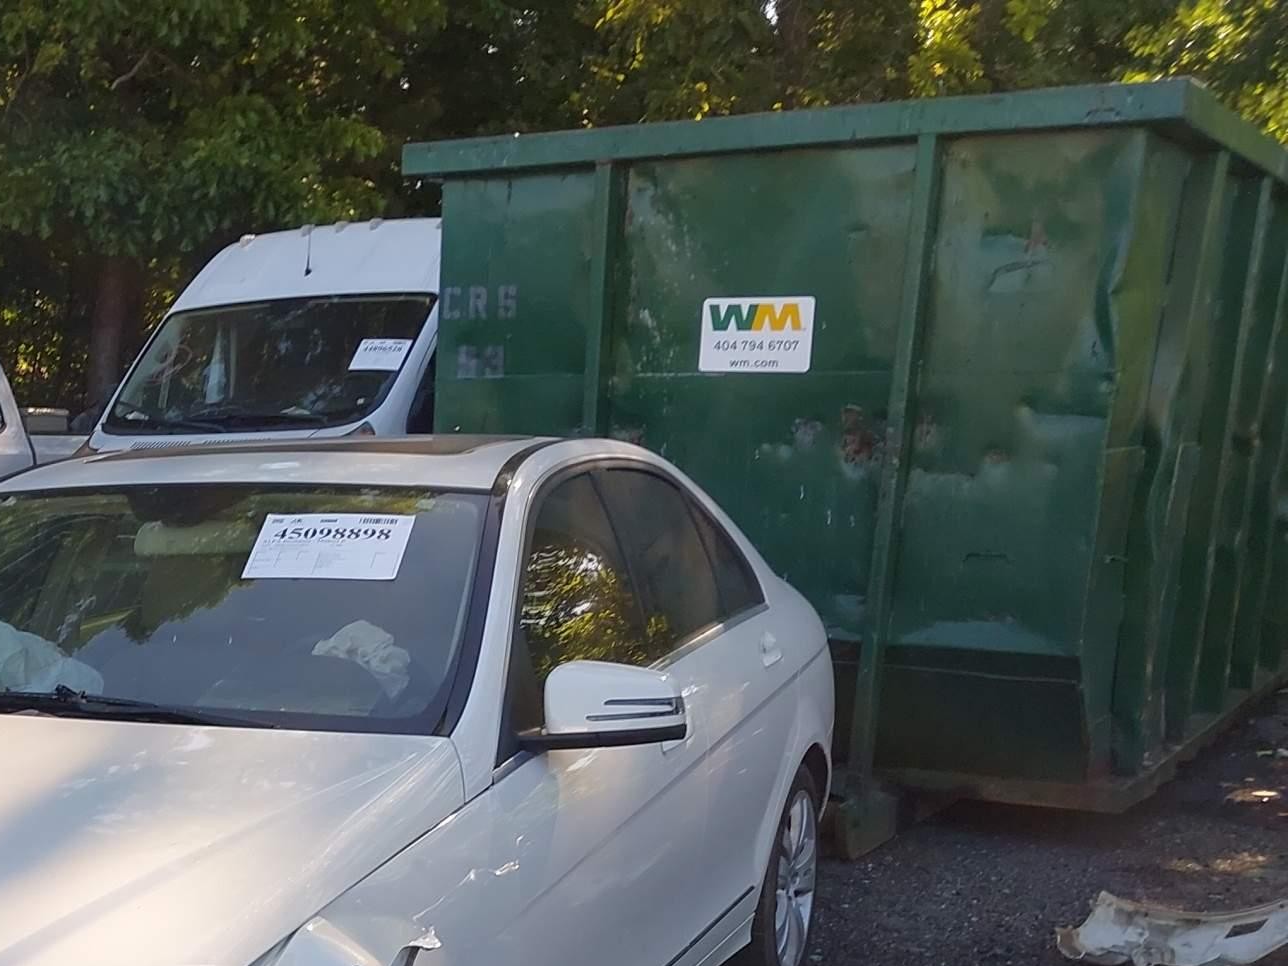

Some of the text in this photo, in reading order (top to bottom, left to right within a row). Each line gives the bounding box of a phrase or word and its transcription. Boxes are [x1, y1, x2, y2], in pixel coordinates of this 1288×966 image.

[709, 303, 802, 331] WM
[714, 340, 799, 351] 404 794 6707
[729, 359, 779, 368] wm.com
[273, 527, 392, 541] 45098898
